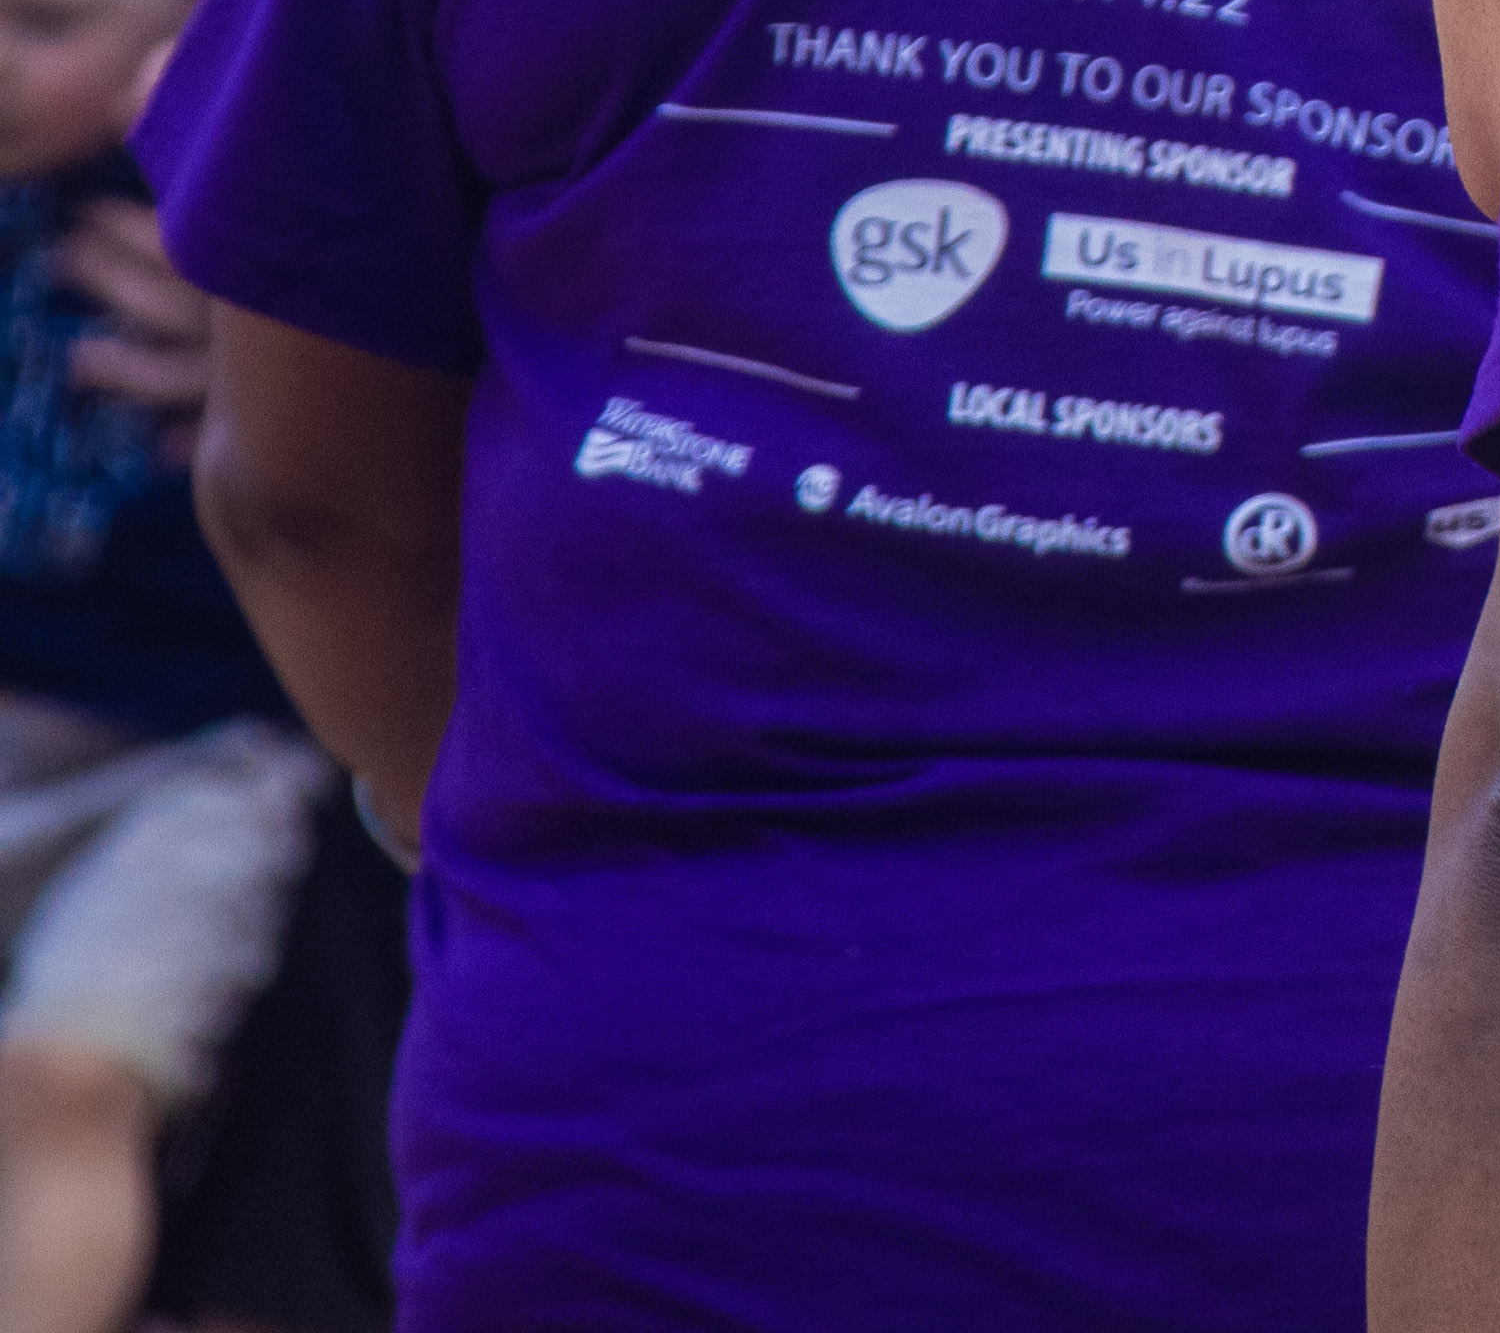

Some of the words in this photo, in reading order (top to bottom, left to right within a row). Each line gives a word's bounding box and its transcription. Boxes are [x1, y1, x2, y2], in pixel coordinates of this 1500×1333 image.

[768, 20, 928, 80] THANK
[938, 37, 1045, 94] YOU
[1054, 49, 1125, 102] TO
[1132, 63, 1236, 119] OUR
[944, 112, 1146, 179] PRESENTING
[1146, 137, 1297, 199] SPONSOR
[845, 205, 977, 290] gsk
[1076, 227, 1140, 275] Us
[1202, 243, 1348, 307] Lupus
[1064, 288, 1161, 328] Power
[1160, 302, 1258, 343] against
[1257, 315, 1340, 359] lupus
[947, 379, 1049, 432] LOCAL
[1051, 394, 1224, 454] SPONSORS
